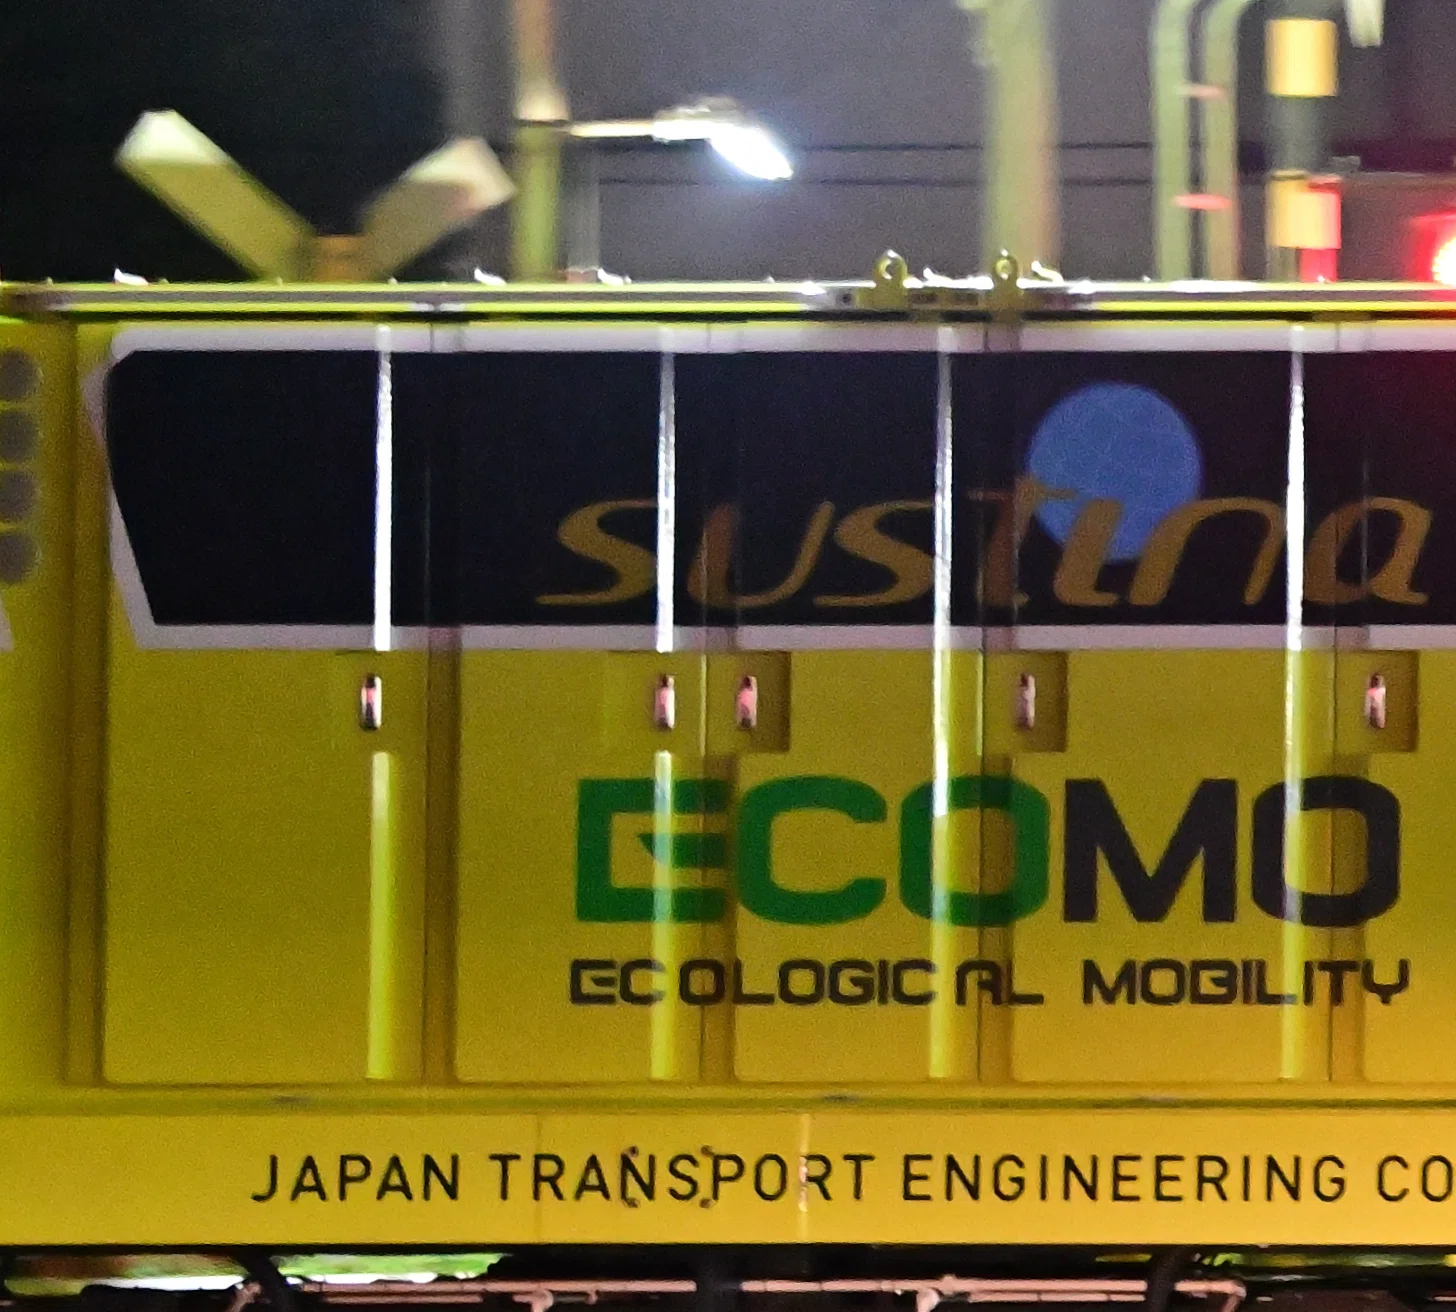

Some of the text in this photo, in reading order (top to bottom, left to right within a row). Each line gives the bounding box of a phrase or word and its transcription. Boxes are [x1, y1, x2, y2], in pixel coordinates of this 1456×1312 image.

[576, 774, 1400, 927] ECOMO
[570, 958, 1411, 1007] ECOLOGICAL MOBILITY
[250, 1153, 460, 1203] JAPAN
[490, 1153, 875, 1203] TRANSPORT
[903, 1153, 1347, 1202] ENGINEERING
